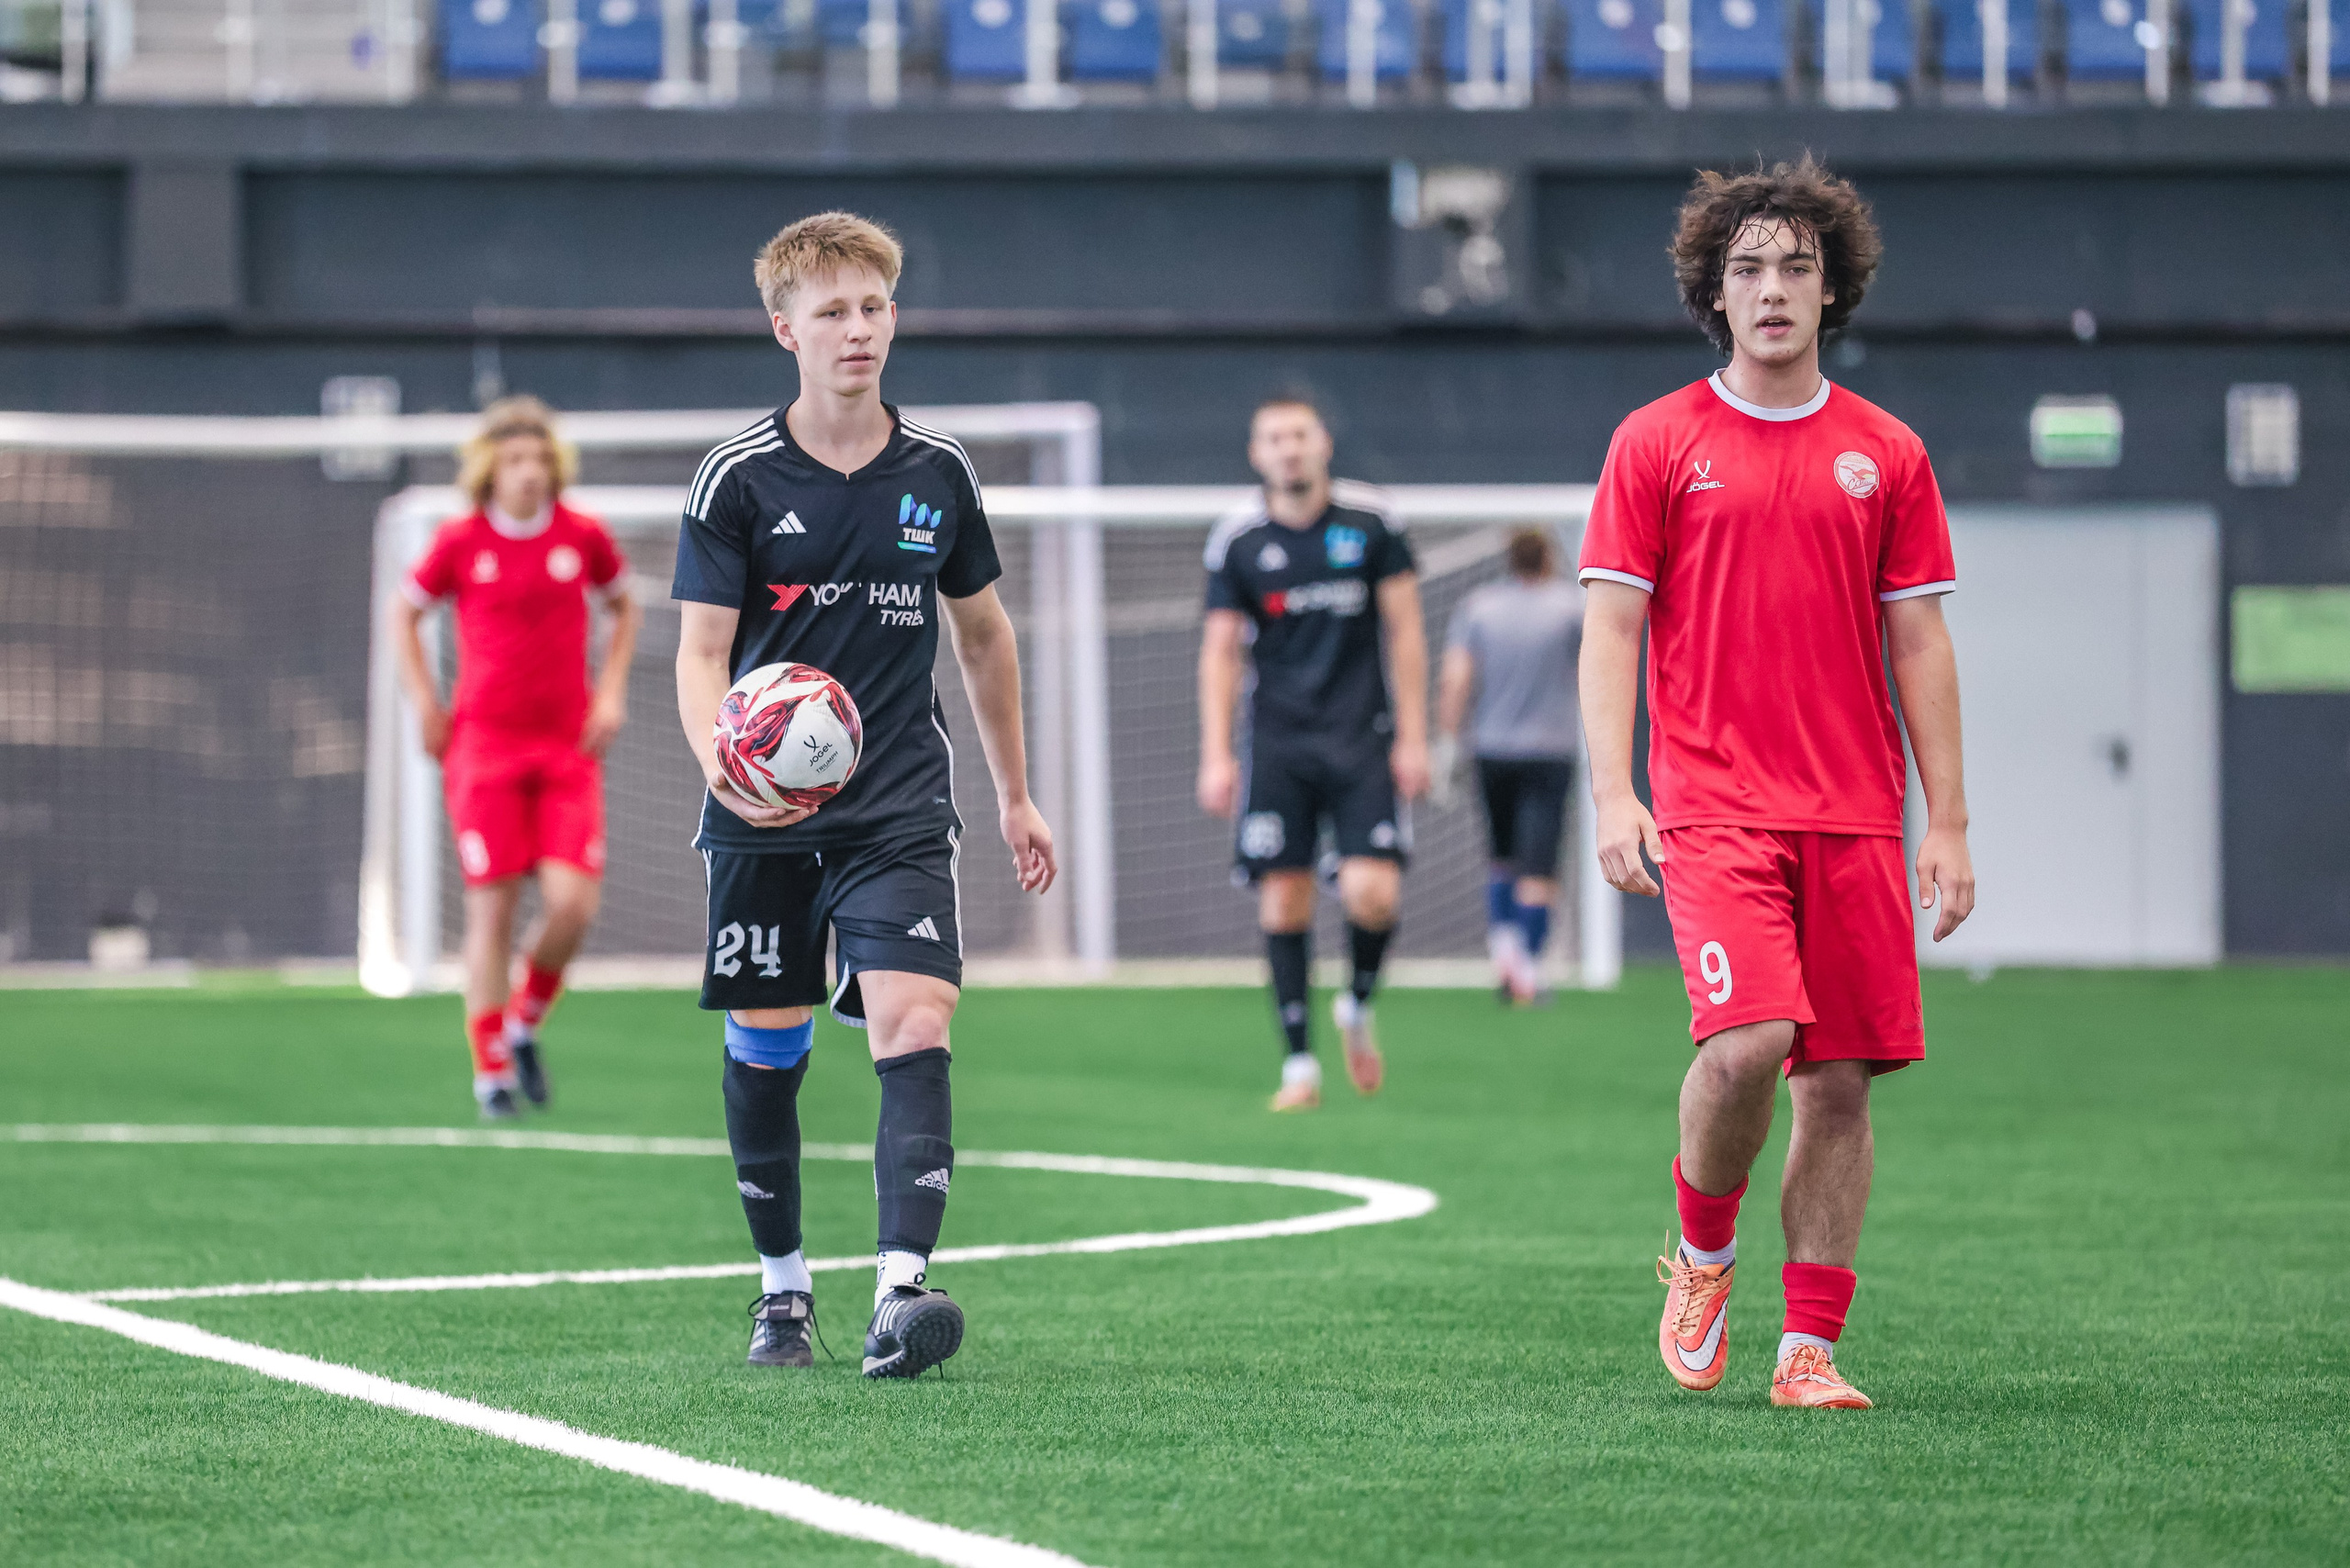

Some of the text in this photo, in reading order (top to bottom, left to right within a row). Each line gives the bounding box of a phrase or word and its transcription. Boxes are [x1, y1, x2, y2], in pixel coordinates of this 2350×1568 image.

[1685, 480, 1726, 494] JÖGEL
[809, 581, 923, 607] YOHAM
[816, 750, 839, 774] TRIUMPH
[712, 921, 783, 979] 24
[1699, 940, 1733, 1005] 9
[914, 1178, 949, 1194] adida
